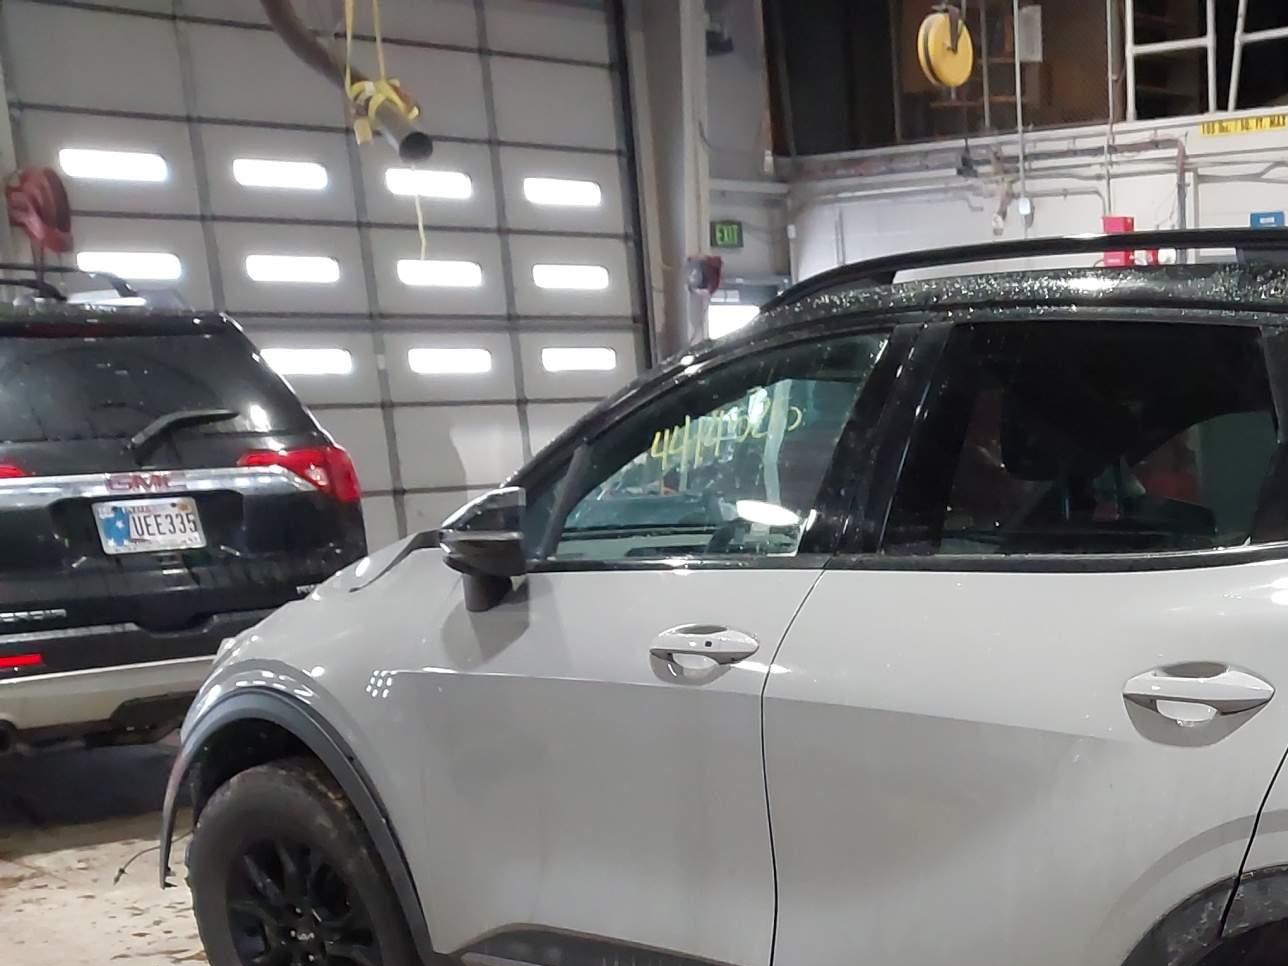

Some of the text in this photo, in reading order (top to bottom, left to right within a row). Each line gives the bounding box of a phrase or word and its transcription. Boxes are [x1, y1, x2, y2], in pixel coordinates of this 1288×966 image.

[715, 224, 738, 244] EXIT
[105, 474, 188, 492] GMC
[131, 512, 198, 537] UEE335
